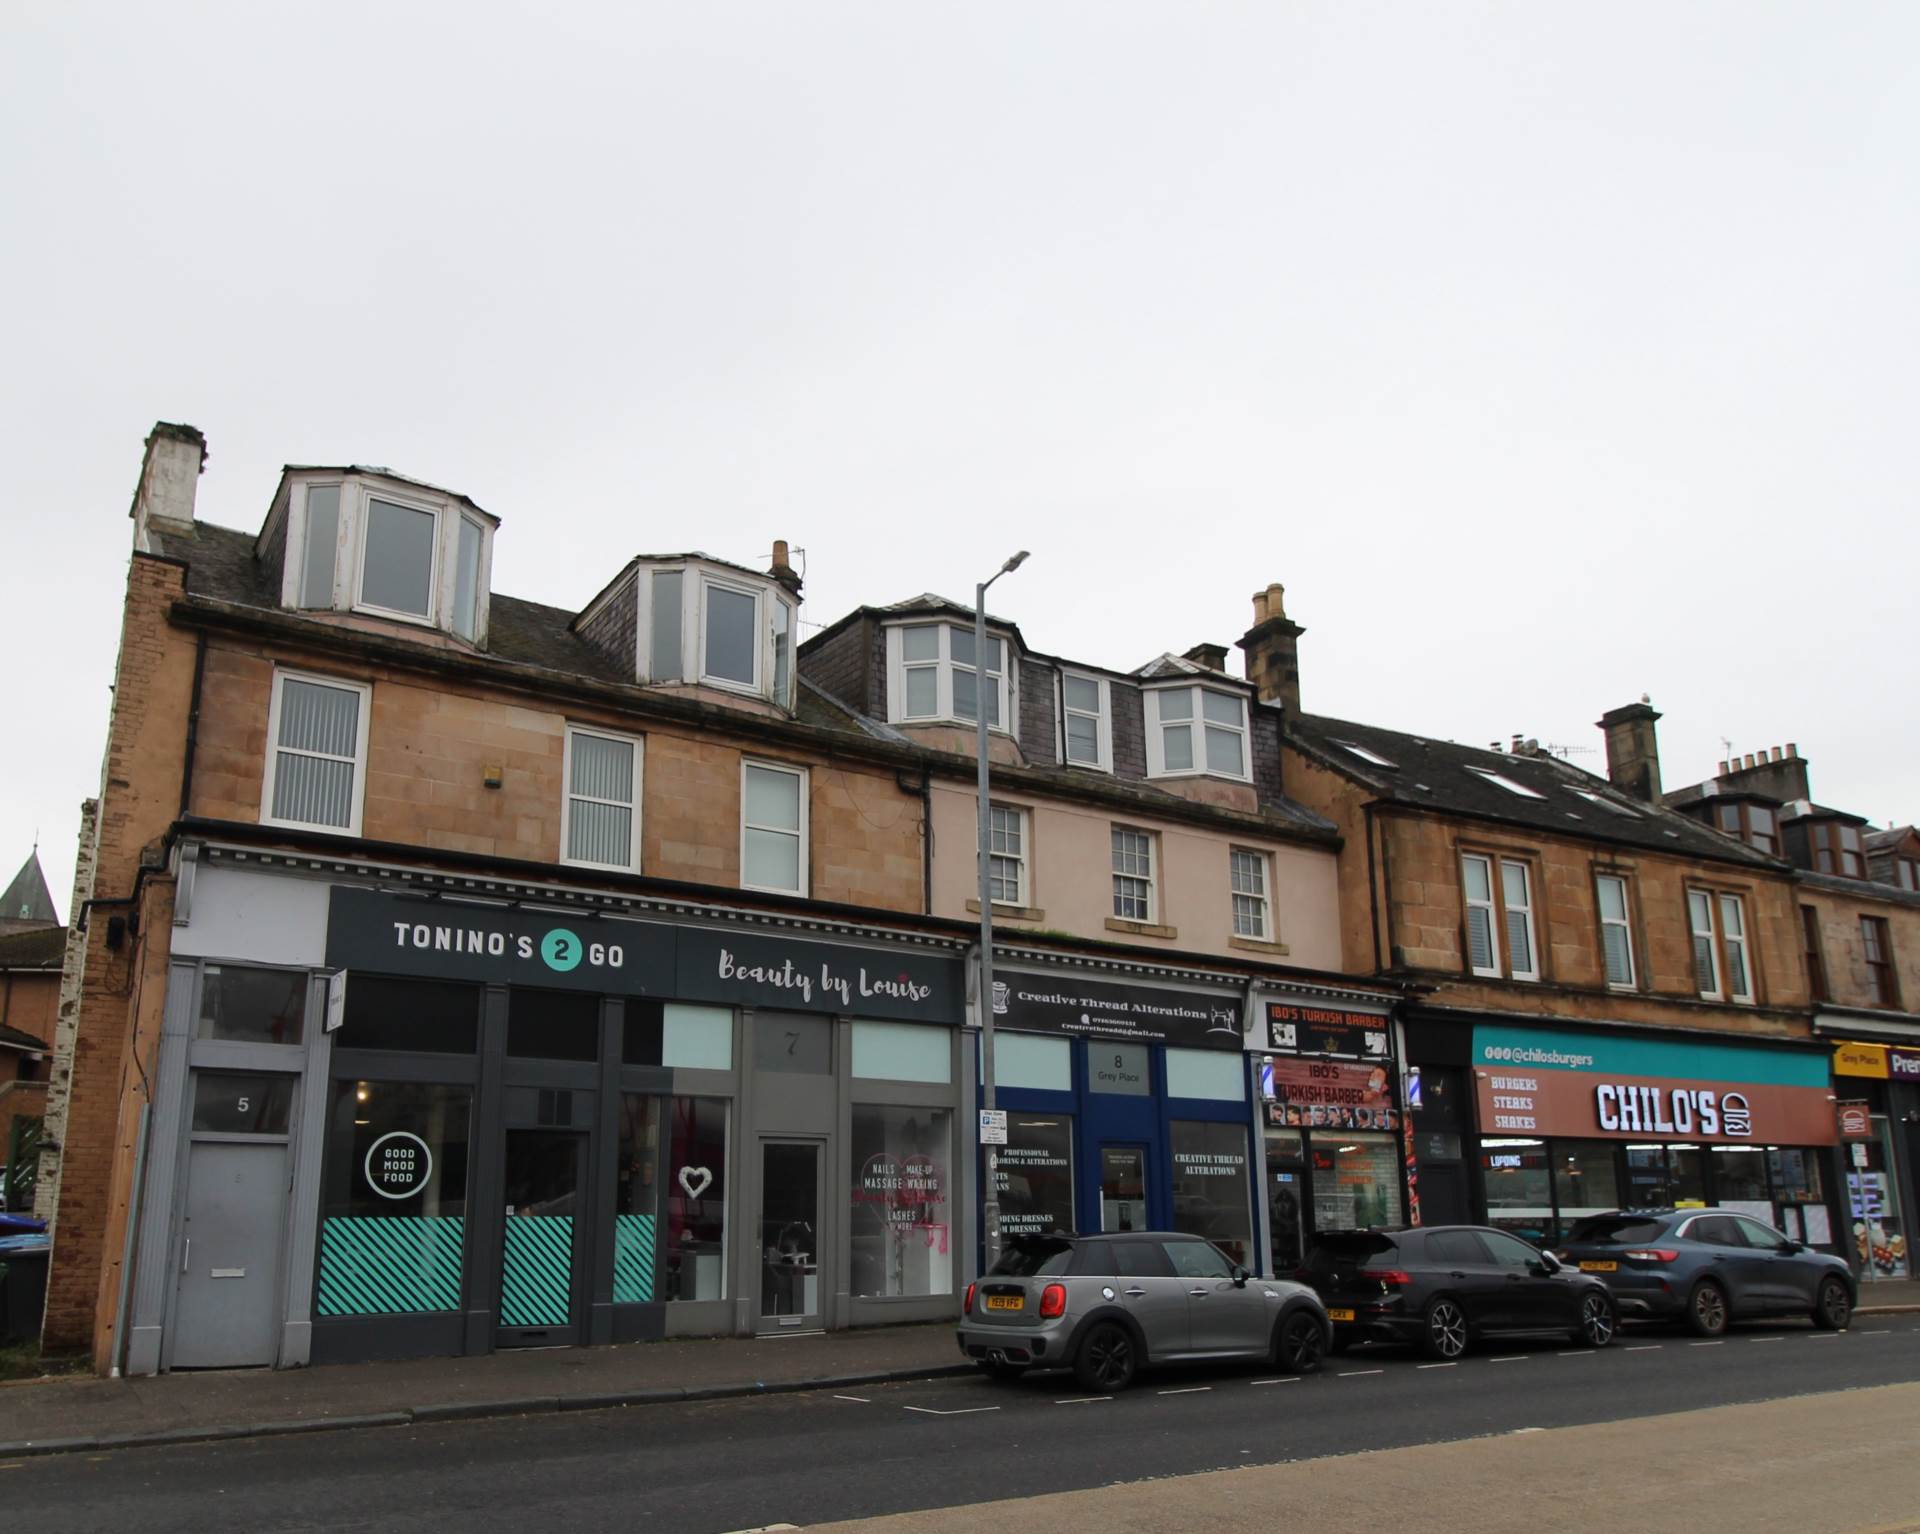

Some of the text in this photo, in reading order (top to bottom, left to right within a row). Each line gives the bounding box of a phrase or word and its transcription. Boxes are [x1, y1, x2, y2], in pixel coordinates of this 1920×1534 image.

[393, 921, 624, 967] TONINO'S 2 GO
[718, 948, 932, 1006] Beauty by Louise
[1017, 990, 1208, 1020] Creative Thread Alterations
[1272, 1005, 1298, 1020] IBO'S
[1302, 1009, 1343, 1025] TURKISH
[1346, 1013, 1386, 1029] BARBER
[784, 1031, 800, 1056] 7
[1114, 1055, 1123, 1069] 8
[1511, 1047, 1593, 1069] @chilosburgers
[1098, 1071, 1140, 1083] Grey Place
[1309, 1064, 1340, 1080] IBO'S
[1491, 1076, 1538, 1091] BURGERS
[1324, 1087, 1364, 1105] BARBER
[237, 1096, 249, 1112] 5
[1493, 1096, 1534, 1110] STEAKS
[1597, 1084, 1719, 1135] CHILO'S
[1495, 1115, 1536, 1129] SHAKES
[385, 1148, 415, 1159] GOOD
[1004, 1149, 1049, 1157] PROFESSIONAL
[1174, 1153, 1244, 1165] CREATIVE THREAD
[384, 1160, 415, 1170] MOOD
[1026, 1158, 1068, 1166] ALTERATIONS
[872, 1163, 934, 1175] NAILS MAKE-UP
[1185, 1165, 1236, 1176] ALTERATIONS
[384, 1173, 413, 1183] FOOD
[864, 1177, 938, 1190] MASSAGE WAXING
[887, 1210, 916, 1222] LASHES
[1021, 1213, 1054, 1223] DRESSES
[897, 1221, 913, 1232] MORE
[1009, 1224, 1042, 1233] DRESSES
